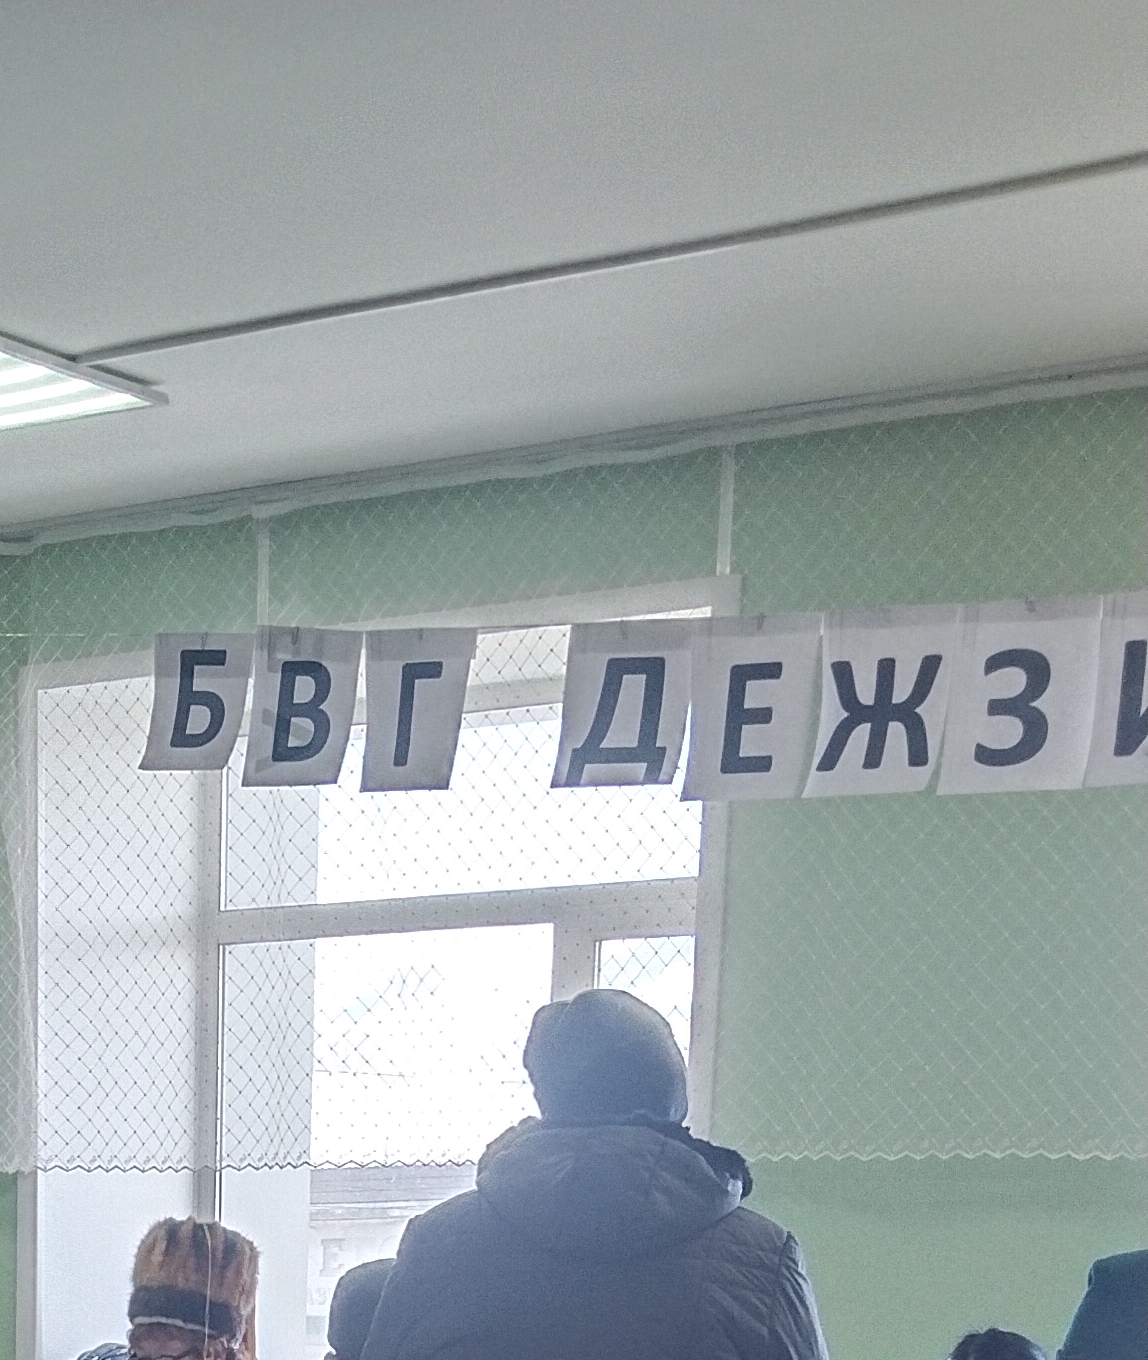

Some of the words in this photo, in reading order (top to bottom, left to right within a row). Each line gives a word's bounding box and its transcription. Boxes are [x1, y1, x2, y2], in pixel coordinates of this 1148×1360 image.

[170, 649, 227, 748] Б
[271, 661, 332, 762] В
[393, 661, 443, 767] Г
[564, 656, 667, 786] Д
[720, 662, 783, 774] Е
[815, 654, 943, 771] Ж
[974, 648, 1051, 767] З
